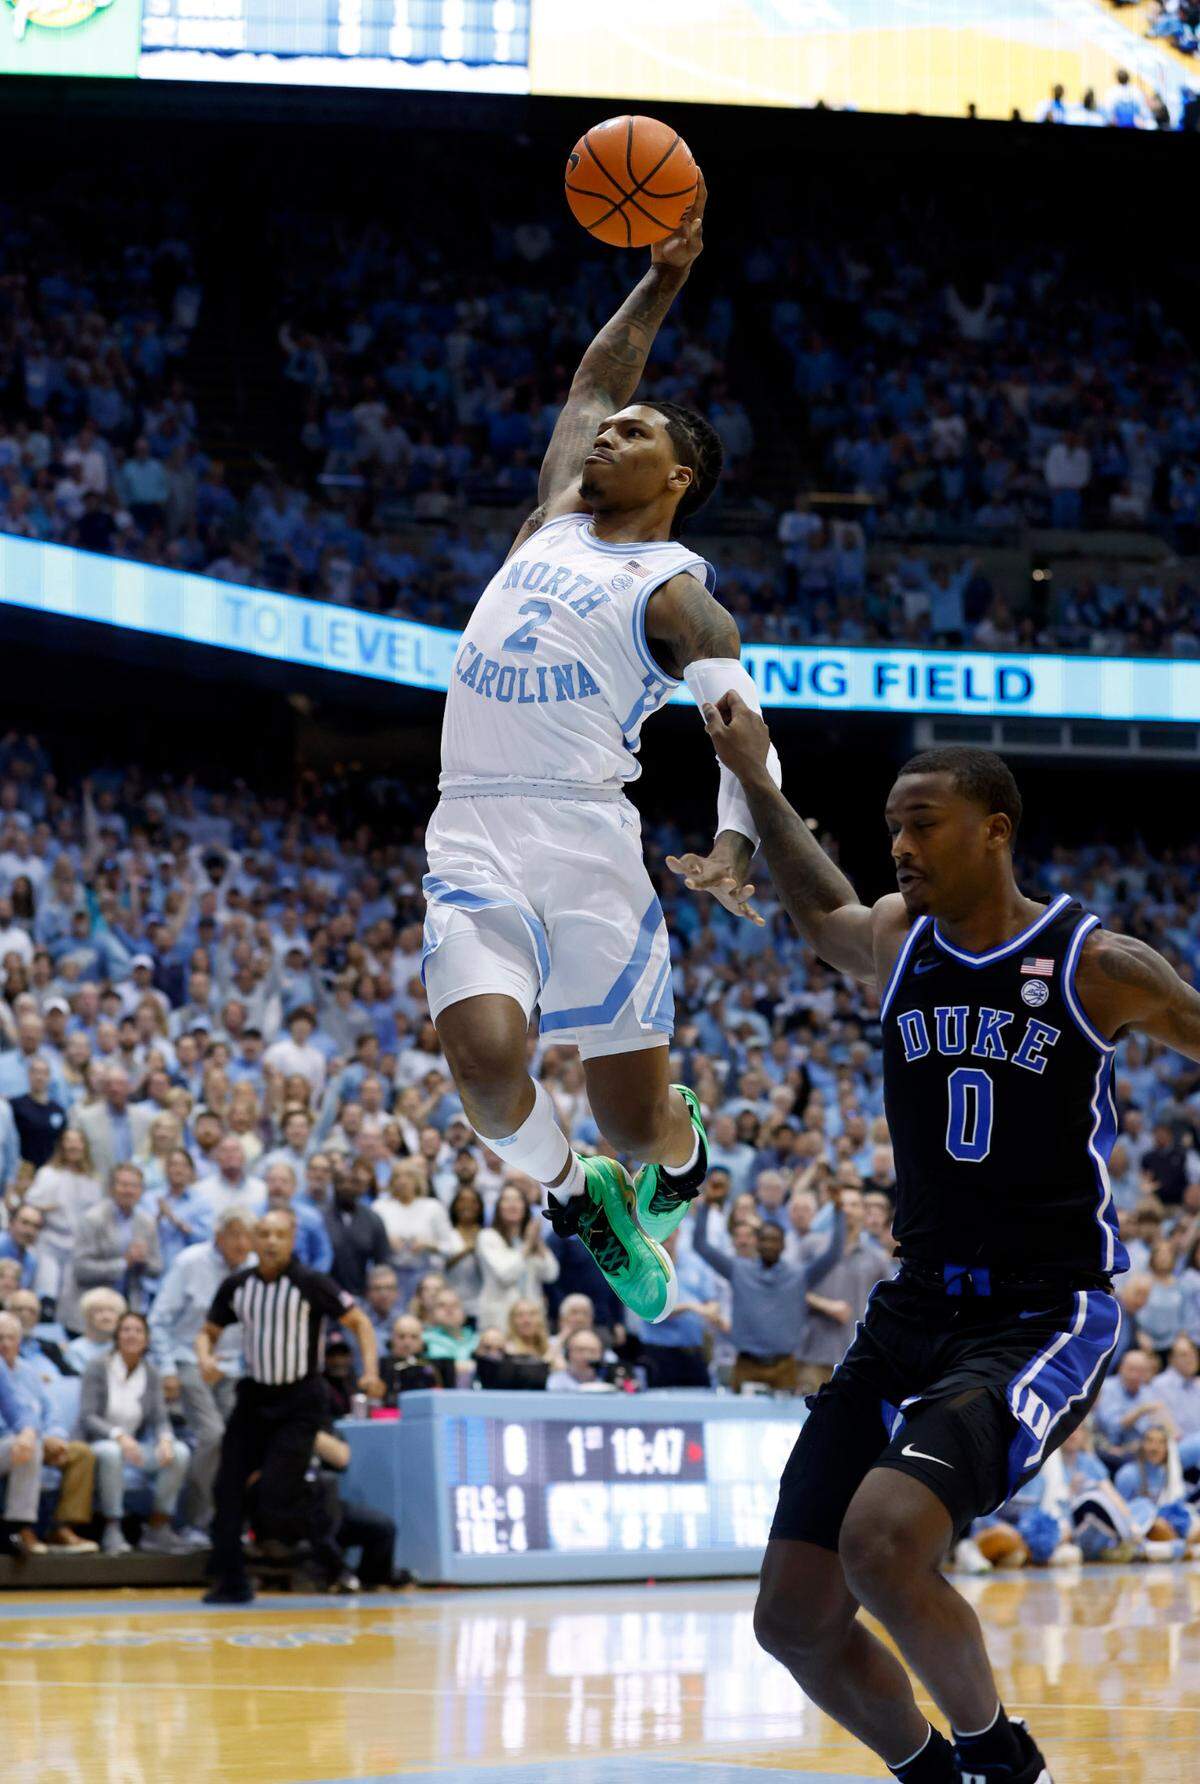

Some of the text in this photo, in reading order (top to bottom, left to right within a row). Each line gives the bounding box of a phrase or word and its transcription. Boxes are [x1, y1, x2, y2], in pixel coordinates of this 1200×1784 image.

[502, 560, 611, 619] NORTH
[223, 597, 282, 643] TO
[302, 613, 435, 678] LEVEL
[873, 663, 1034, 703] FIELD
[501, 599, 552, 655] 2
[456, 641, 601, 704] CAROLINA
[897, 1006, 1061, 1074] DUKE
[946, 1067, 993, 1162] 0
